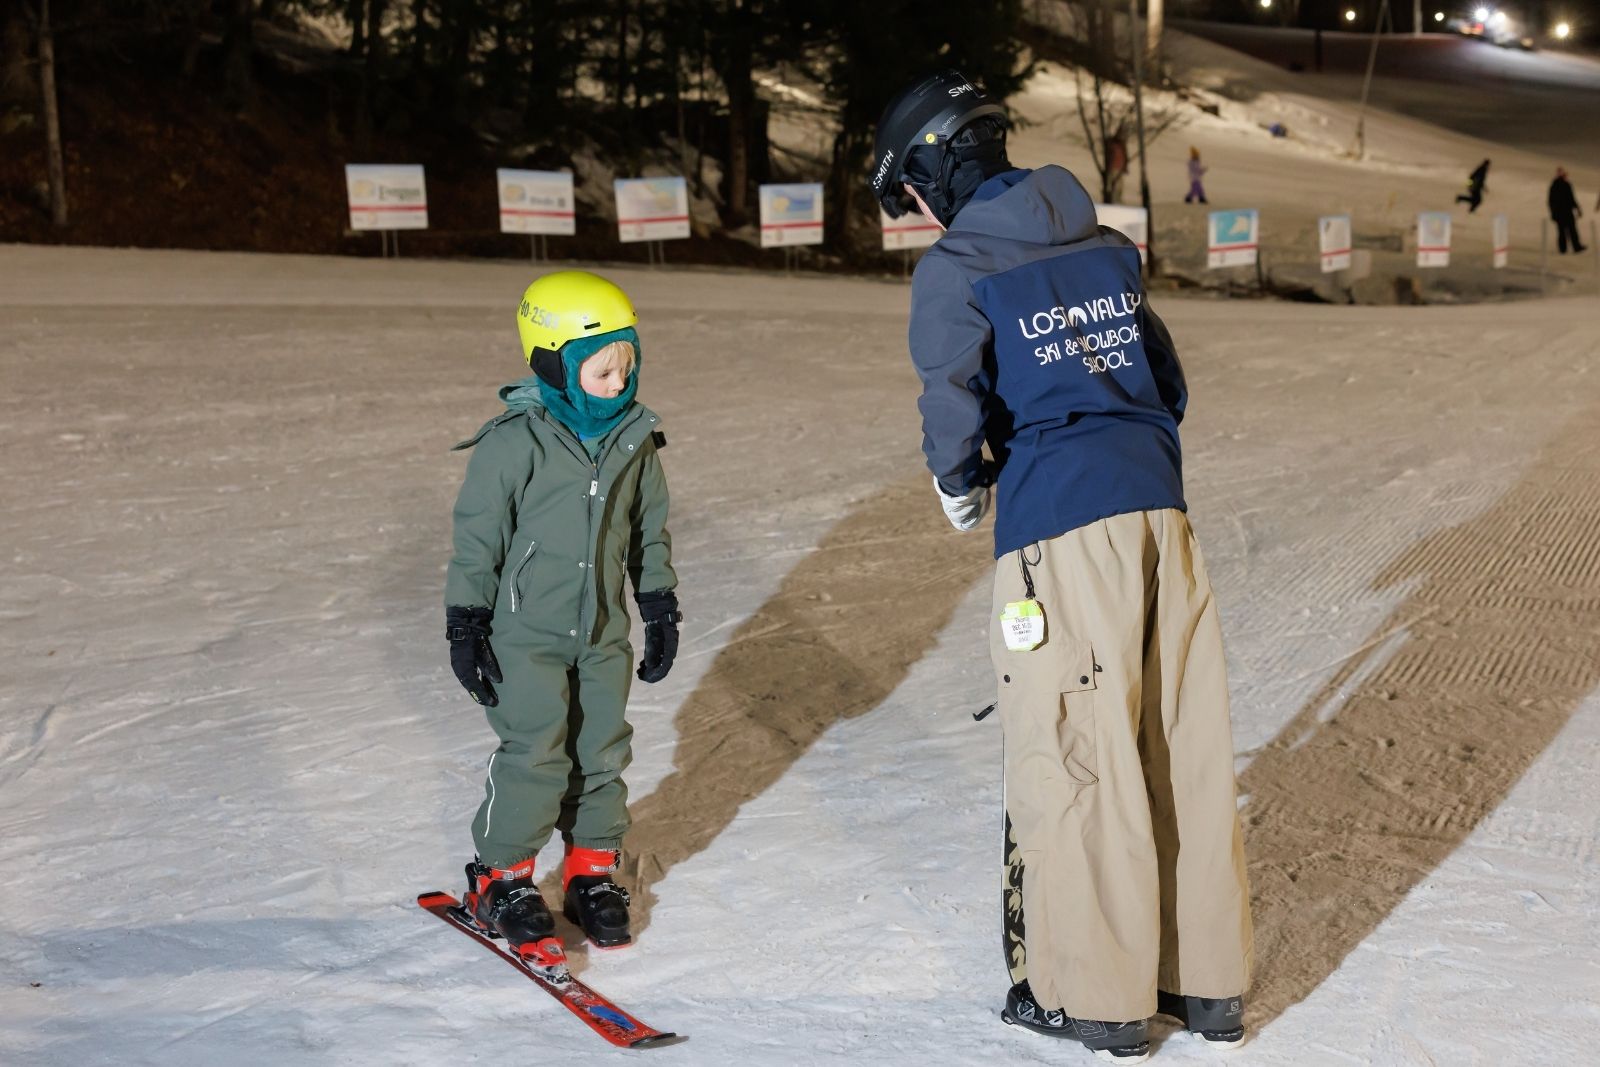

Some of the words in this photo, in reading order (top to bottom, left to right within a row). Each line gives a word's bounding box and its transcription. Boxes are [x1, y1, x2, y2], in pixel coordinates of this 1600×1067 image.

[872, 149, 894, 189] SMITH
[1034, 342, 1062, 366] SKI
[1065, 338, 1080, 356] &
